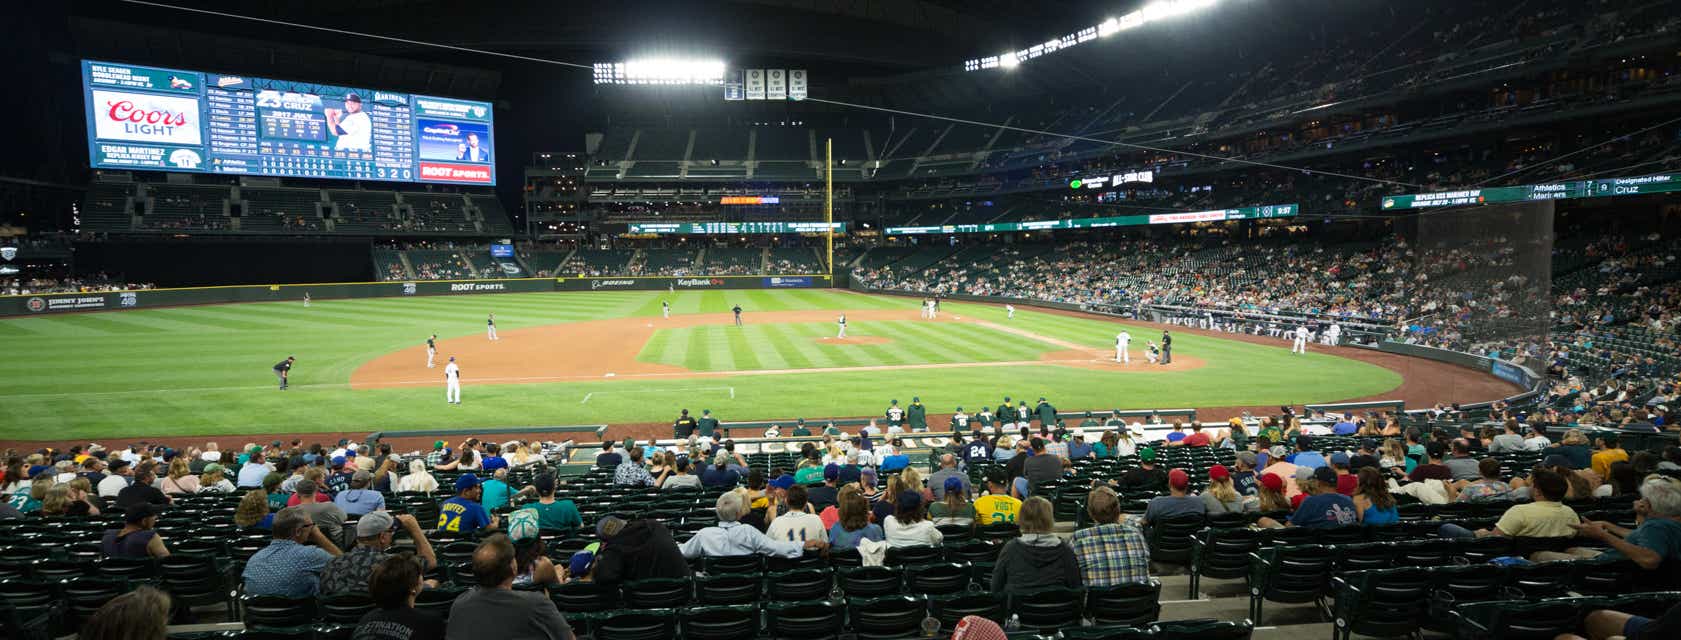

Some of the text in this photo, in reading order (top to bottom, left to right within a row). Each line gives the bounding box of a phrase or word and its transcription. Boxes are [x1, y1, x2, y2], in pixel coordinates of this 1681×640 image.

[256, 90, 281, 108] 23
[284, 102, 312, 111] CRUZ
[107, 100, 186, 127] Coors
[124, 123, 175, 136] LIGHT
[102, 145, 127, 153] EDGAR
[377, 168, 410, 179] 3 2 0
[422, 166, 452, 177] ROOT
[1616, 177, 1652, 185] Designated
[1533, 184, 1566, 192] Athletics
[1615, 185, 1639, 194] Cruz
[1587, 189, 1592, 197] 1
[451, 283, 475, 291] ROOT
[678, 279, 711, 287] KeyBank
[48, 298, 76, 306] JIMMY
[890, 412, 901, 421] 30
[970, 445, 986, 458] 24
[994, 501, 1014, 511] VOGT
[437, 513, 461, 532] 24
[786, 527, 806, 541] 11
